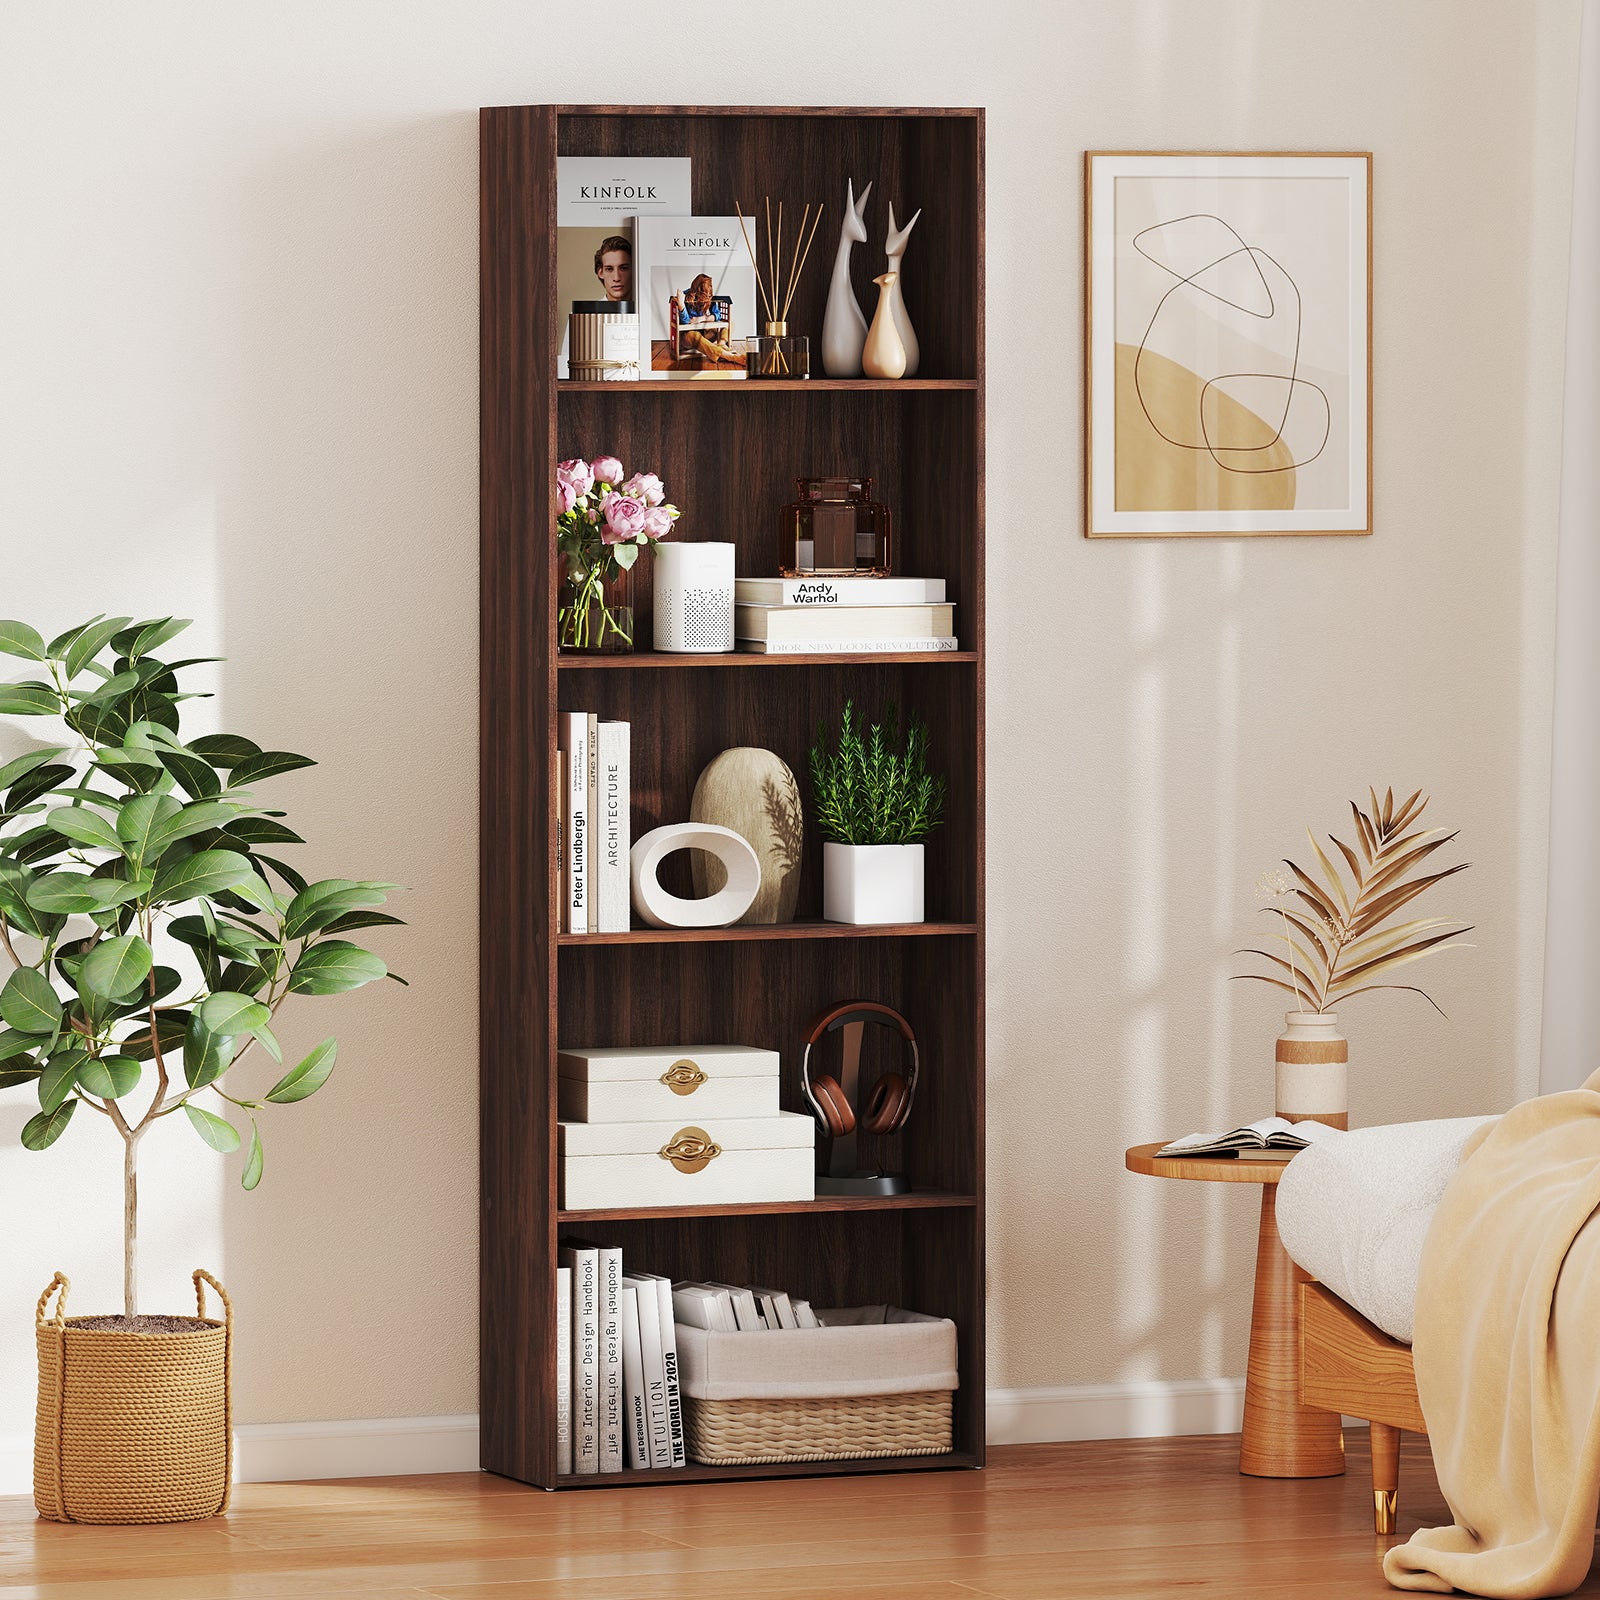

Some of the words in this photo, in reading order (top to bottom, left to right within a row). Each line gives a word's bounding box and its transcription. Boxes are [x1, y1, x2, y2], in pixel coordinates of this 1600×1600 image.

[580, 186, 657, 199] KINFOLK
[673, 238, 730, 248] KINFOLK
[792, 593, 838, 604] Warhol
[799, 583, 833, 595] Andy
[808, 642, 834, 652] NEW
[839, 642, 872, 651] LOOK
[876, 640, 953, 650] REVOLUTION
[608, 764, 618, 867] ARCHITECTURE
[573, 811, 585, 872] Lindbergh
[573, 878, 583, 908] Peter
[582, 1259, 593, 1316] Handbook
[558, 1296, 569, 1366] DECORATES
[582, 1322, 595, 1364] Design
[664, 1352, 678, 1382] 2020
[582, 1371, 593, 1427] Interior
[667, 1384, 679, 1397] IN
[558, 1373, 569, 1443] HOUSEHOLD
[650, 1381, 668, 1463] INTUITION
[669, 1398, 682, 1440] WORLD
[582, 1434, 593, 1456] The
[672, 1441, 684, 1463] THE
